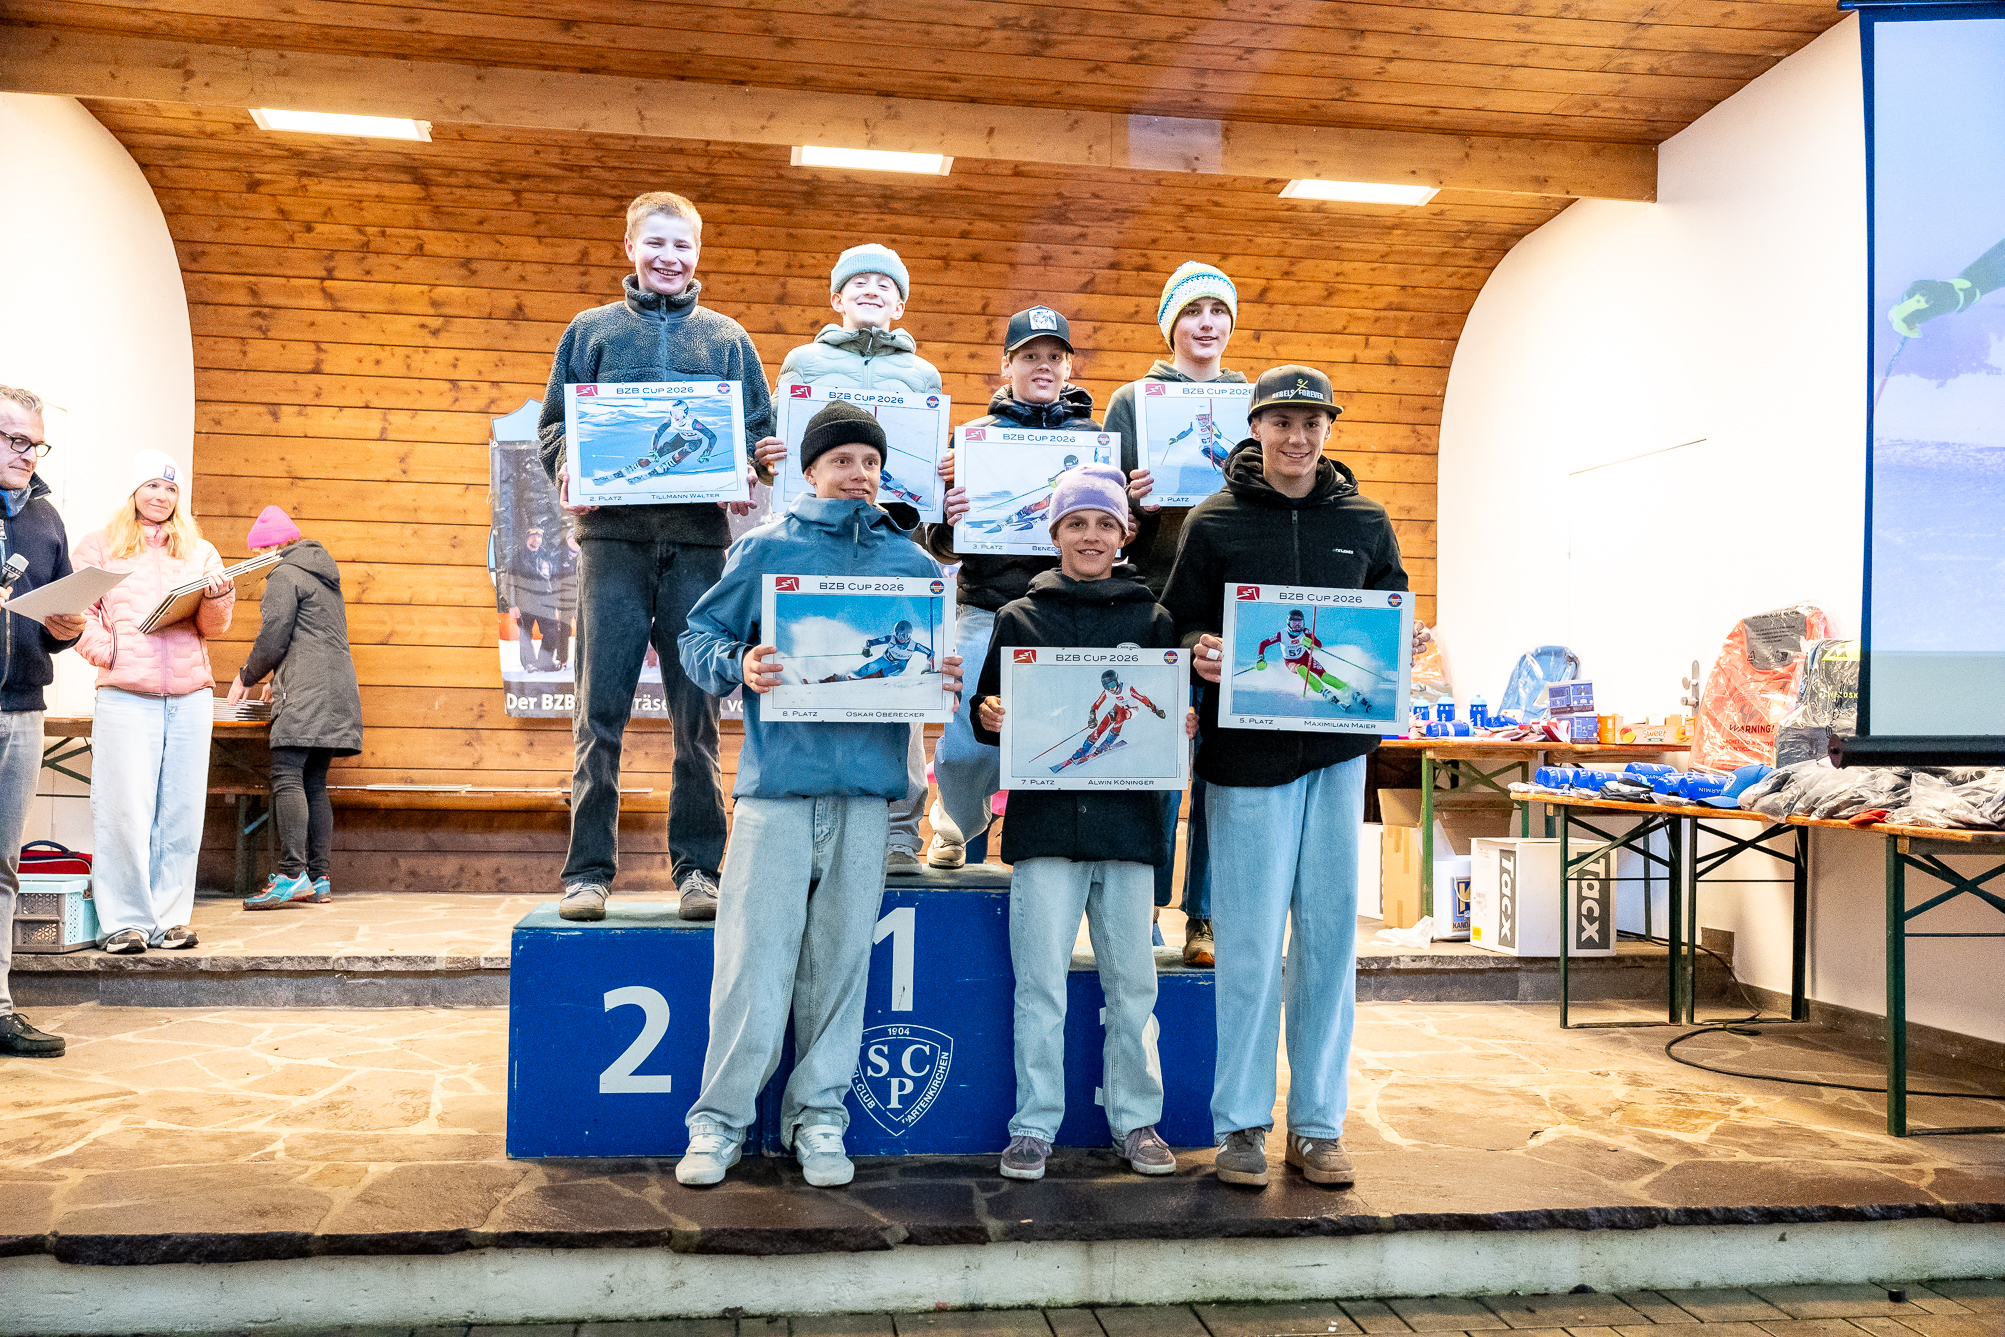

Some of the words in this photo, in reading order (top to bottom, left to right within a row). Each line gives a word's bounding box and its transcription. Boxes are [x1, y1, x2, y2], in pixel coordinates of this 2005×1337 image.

[616, 387, 640, 395] BZB
[666, 386, 694, 394] 2026
[1182, 387, 1205, 395] BZB
[828, 391, 852, 400] BZB
[877, 395, 904, 404] 2026
[1002, 433, 1025, 441] BZB
[1049, 435, 1076, 443] 2026
[819, 582, 845, 590] BZB
[874, 583, 905, 591] 2026
[1279, 592, 1304, 601] BZB
[1333, 595, 1363, 603] 2026
[1056, 654, 1081, 662] BZB
[1109, 654, 1139, 662] 2026
[506, 693, 538, 711] Der
[541, 693, 576, 711] BZB
[1729, 724, 1775, 734] WARNING!
[1500, 855, 1515, 942] Tacx
[1581, 858, 1606, 944] Tacx
[872, 906, 916, 1012] 1
[887, 1026, 911, 1036] 1904
[598, 985, 672, 1094] 2
[866, 1044, 890, 1078] S
[901, 1044, 931, 1078] C
[886, 1077, 915, 1109] P
